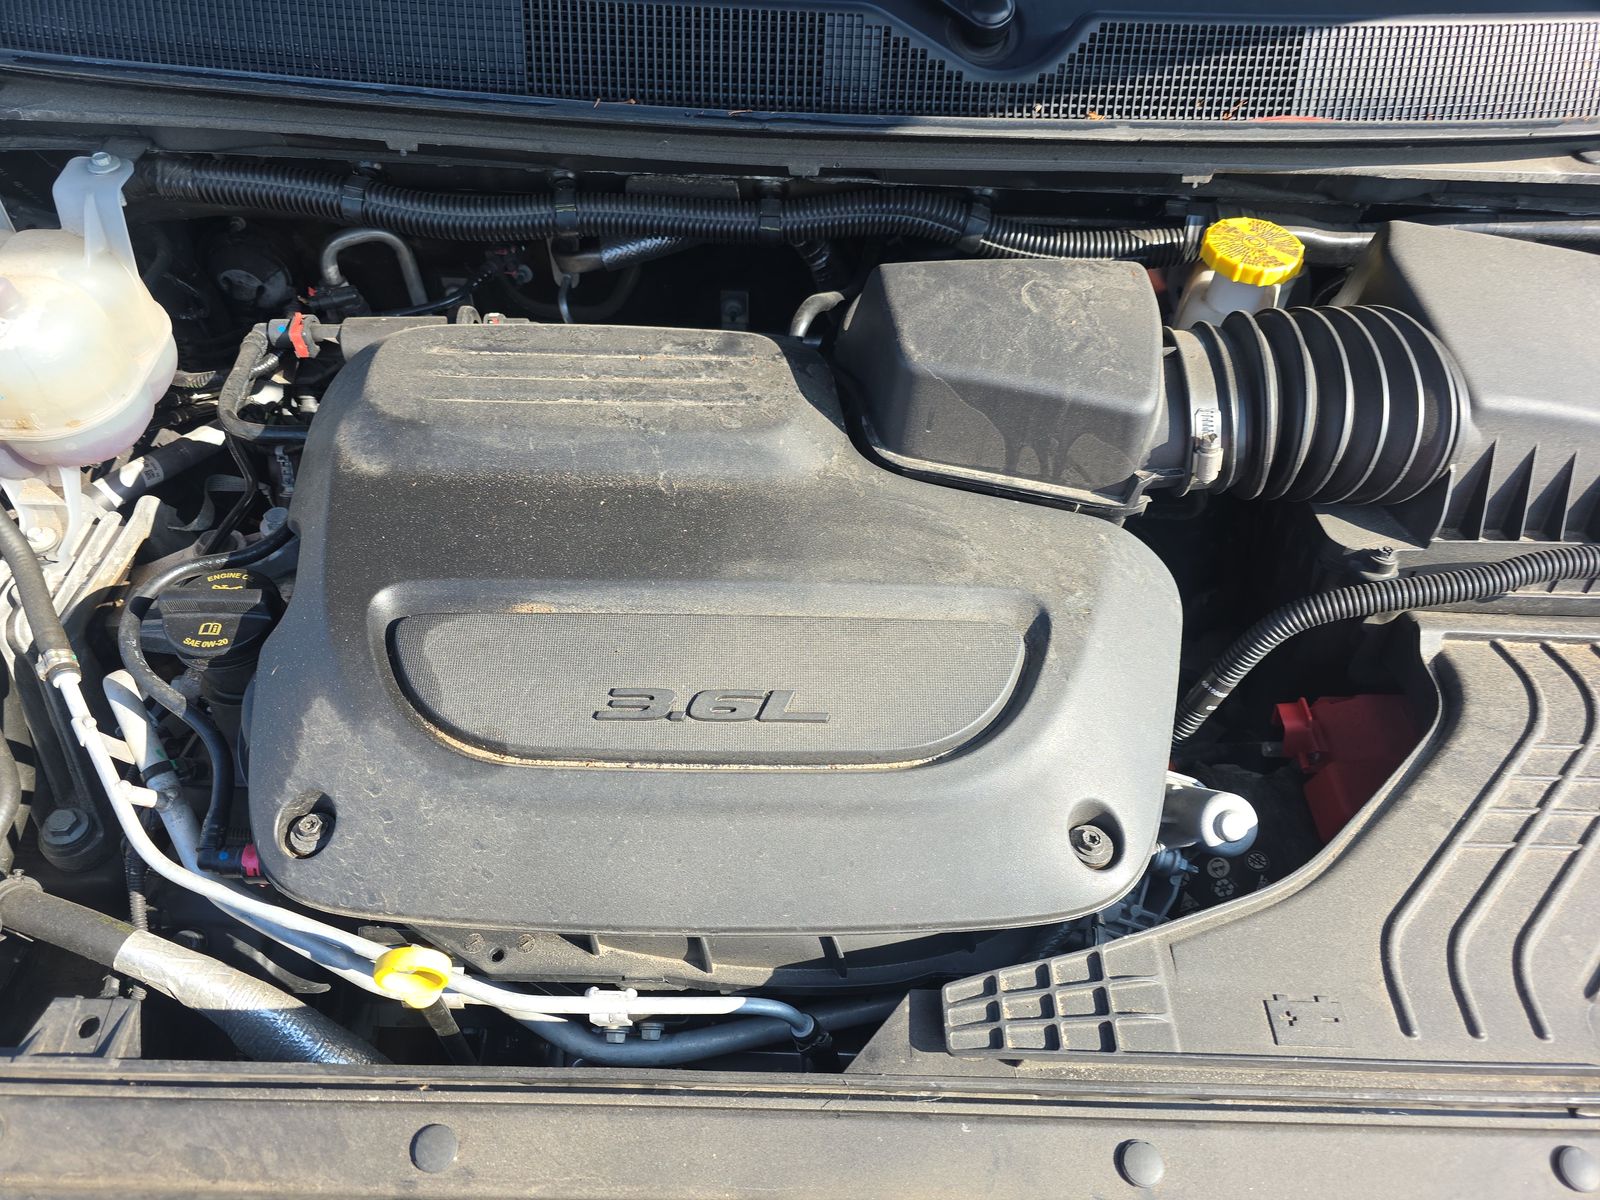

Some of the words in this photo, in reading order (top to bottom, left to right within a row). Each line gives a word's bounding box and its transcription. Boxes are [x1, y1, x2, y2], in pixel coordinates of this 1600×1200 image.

[207, 572, 242, 582] ENGINE
[183, 637, 201, 648] SAE
[201, 638, 229, 648] 0W-20
[591, 687, 830, 723] 3.6L
